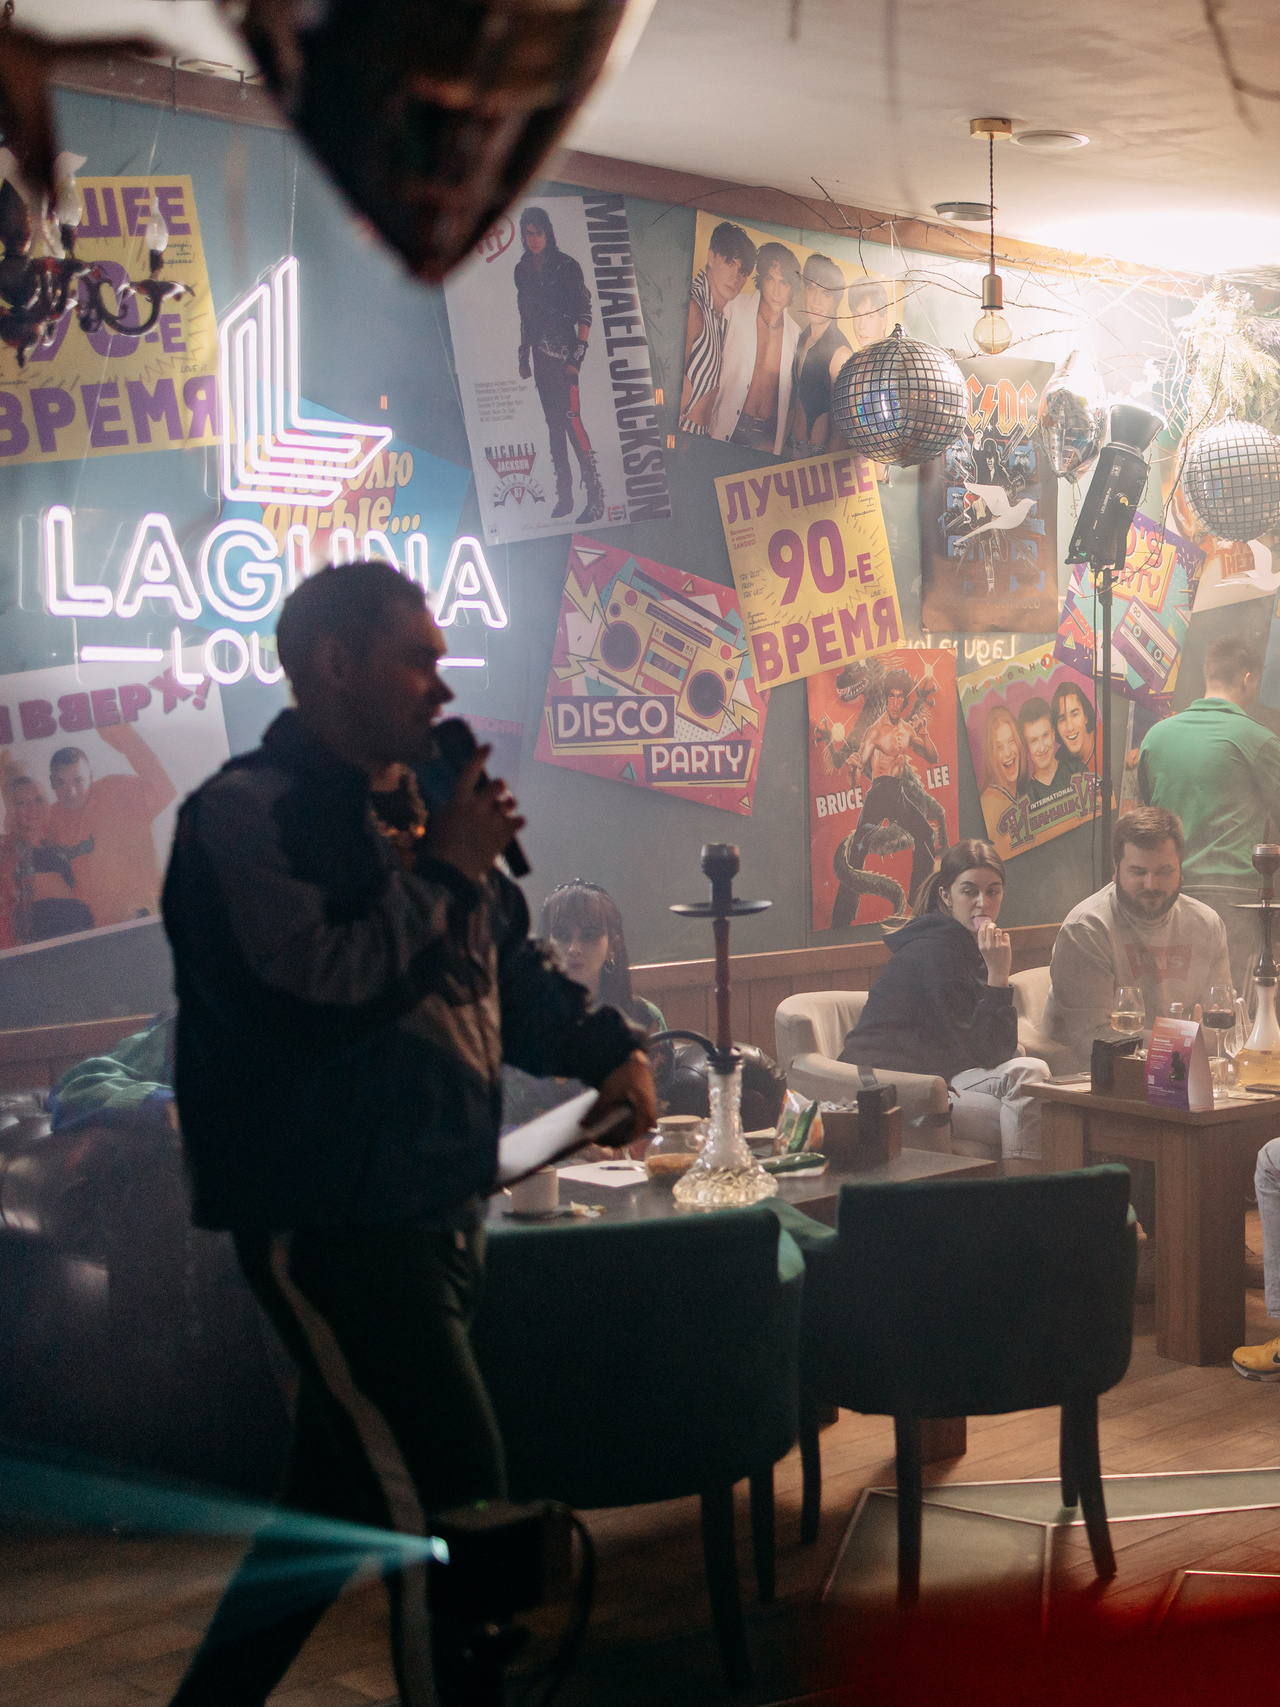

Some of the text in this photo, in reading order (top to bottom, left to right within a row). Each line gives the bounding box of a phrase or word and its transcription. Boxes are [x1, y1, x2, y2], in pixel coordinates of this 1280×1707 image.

[74, 186, 192, 238] ШЕЕ
[582, 195, 649, 357] MICHAEL
[0, 374, 224, 457] ВРЕМЯ
[484, 442, 537, 461] MICHAEL
[608, 358, 673, 523] JACKSON
[497, 458, 530, 473] JACKSON
[725, 456, 874, 525] ЛУЧШЕЕ
[768, 519, 875, 606] 90-Е
[1126, 521, 1165, 569] 0'S
[1110, 562, 1161, 598] RTY
[170, 627, 284, 686] LOU
[751, 595, 900, 684] ВРЕМЯ
[557, 700, 669, 738] DISCO
[651, 744, 745, 775] PARTY
[926, 765, 951, 790] LEE
[815, 787, 864, 818] BRUCE
[1030, 785, 1075, 810] INTERNATIONAL
